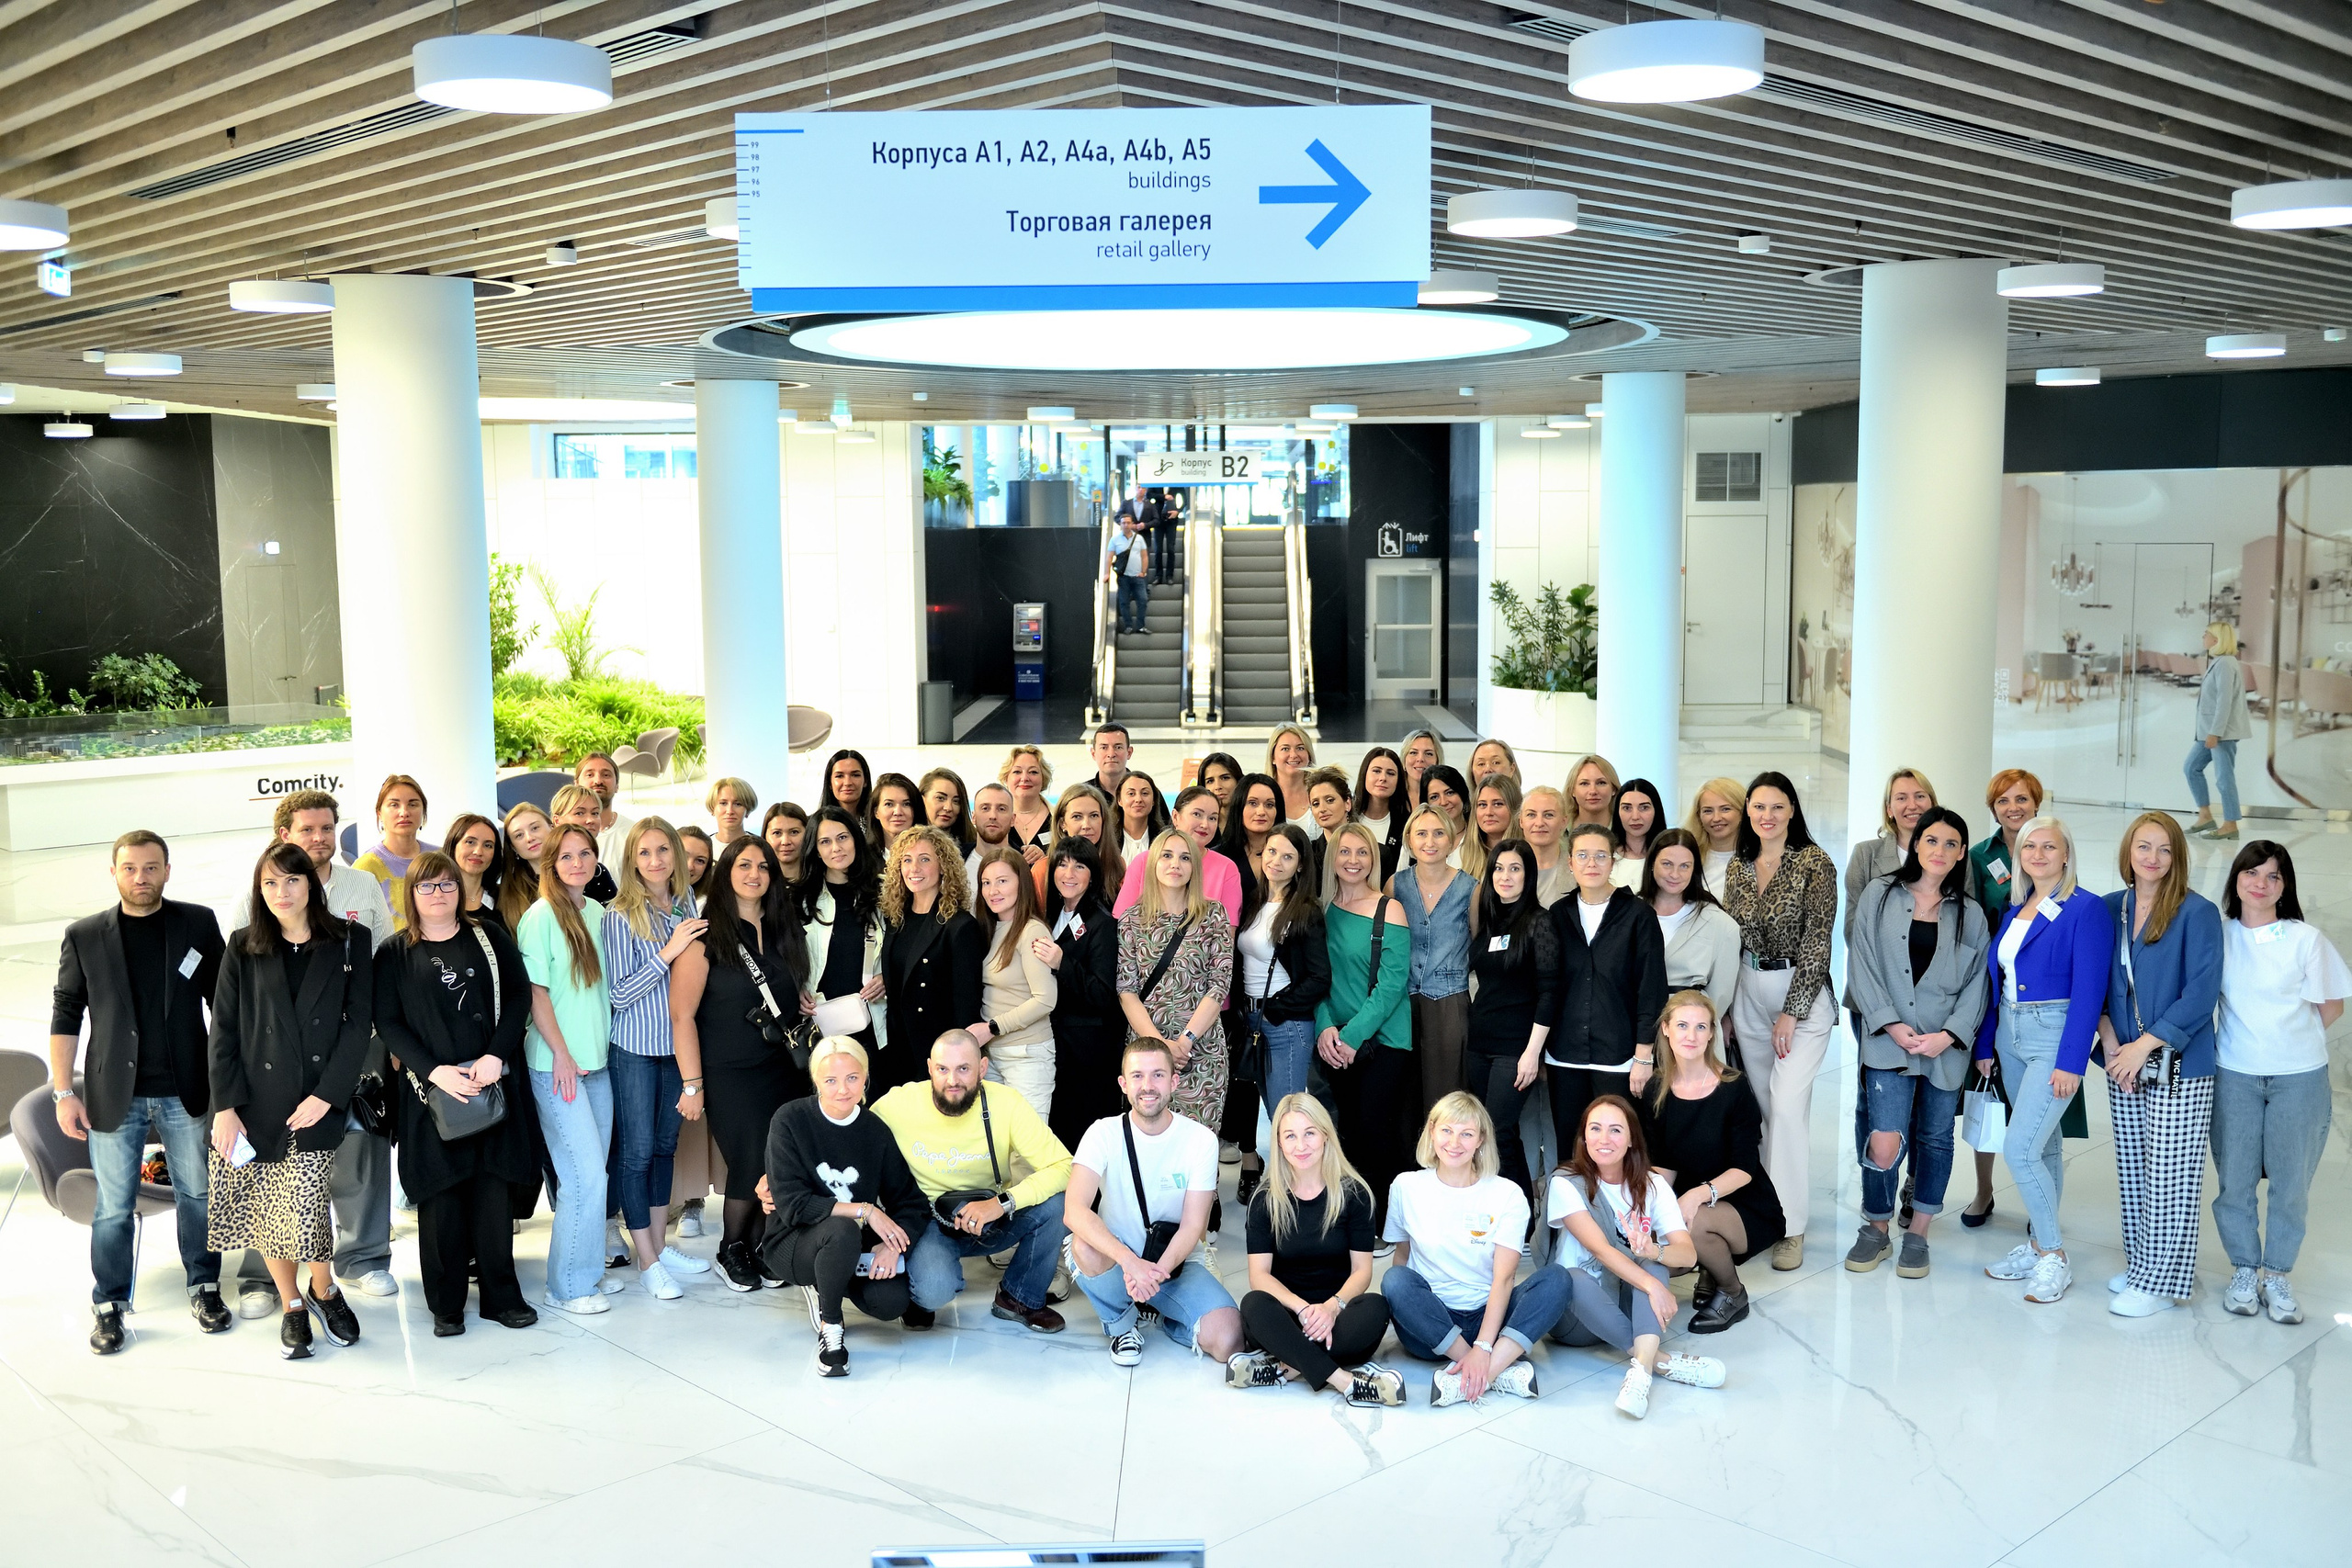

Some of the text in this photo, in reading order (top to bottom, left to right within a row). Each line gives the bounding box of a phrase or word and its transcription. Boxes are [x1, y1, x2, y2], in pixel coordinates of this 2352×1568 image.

[872, 138, 1211, 169] Корпуса A1, A2, A4a, A4b, A5
[1128, 171, 1211, 192] buildings
[1006, 209, 1212, 238] Торговая галерея
[1097, 240, 1211, 262] retail gallery
[1181, 456, 1249, 478] Корпус B2
[1181, 468, 1206, 477] building
[1406, 533, 1429, 544] Лифт
[1406, 544, 1419, 553] lift
[742, 953, 759, 972] KORS
[911, 1141, 947, 1166] Pepe
